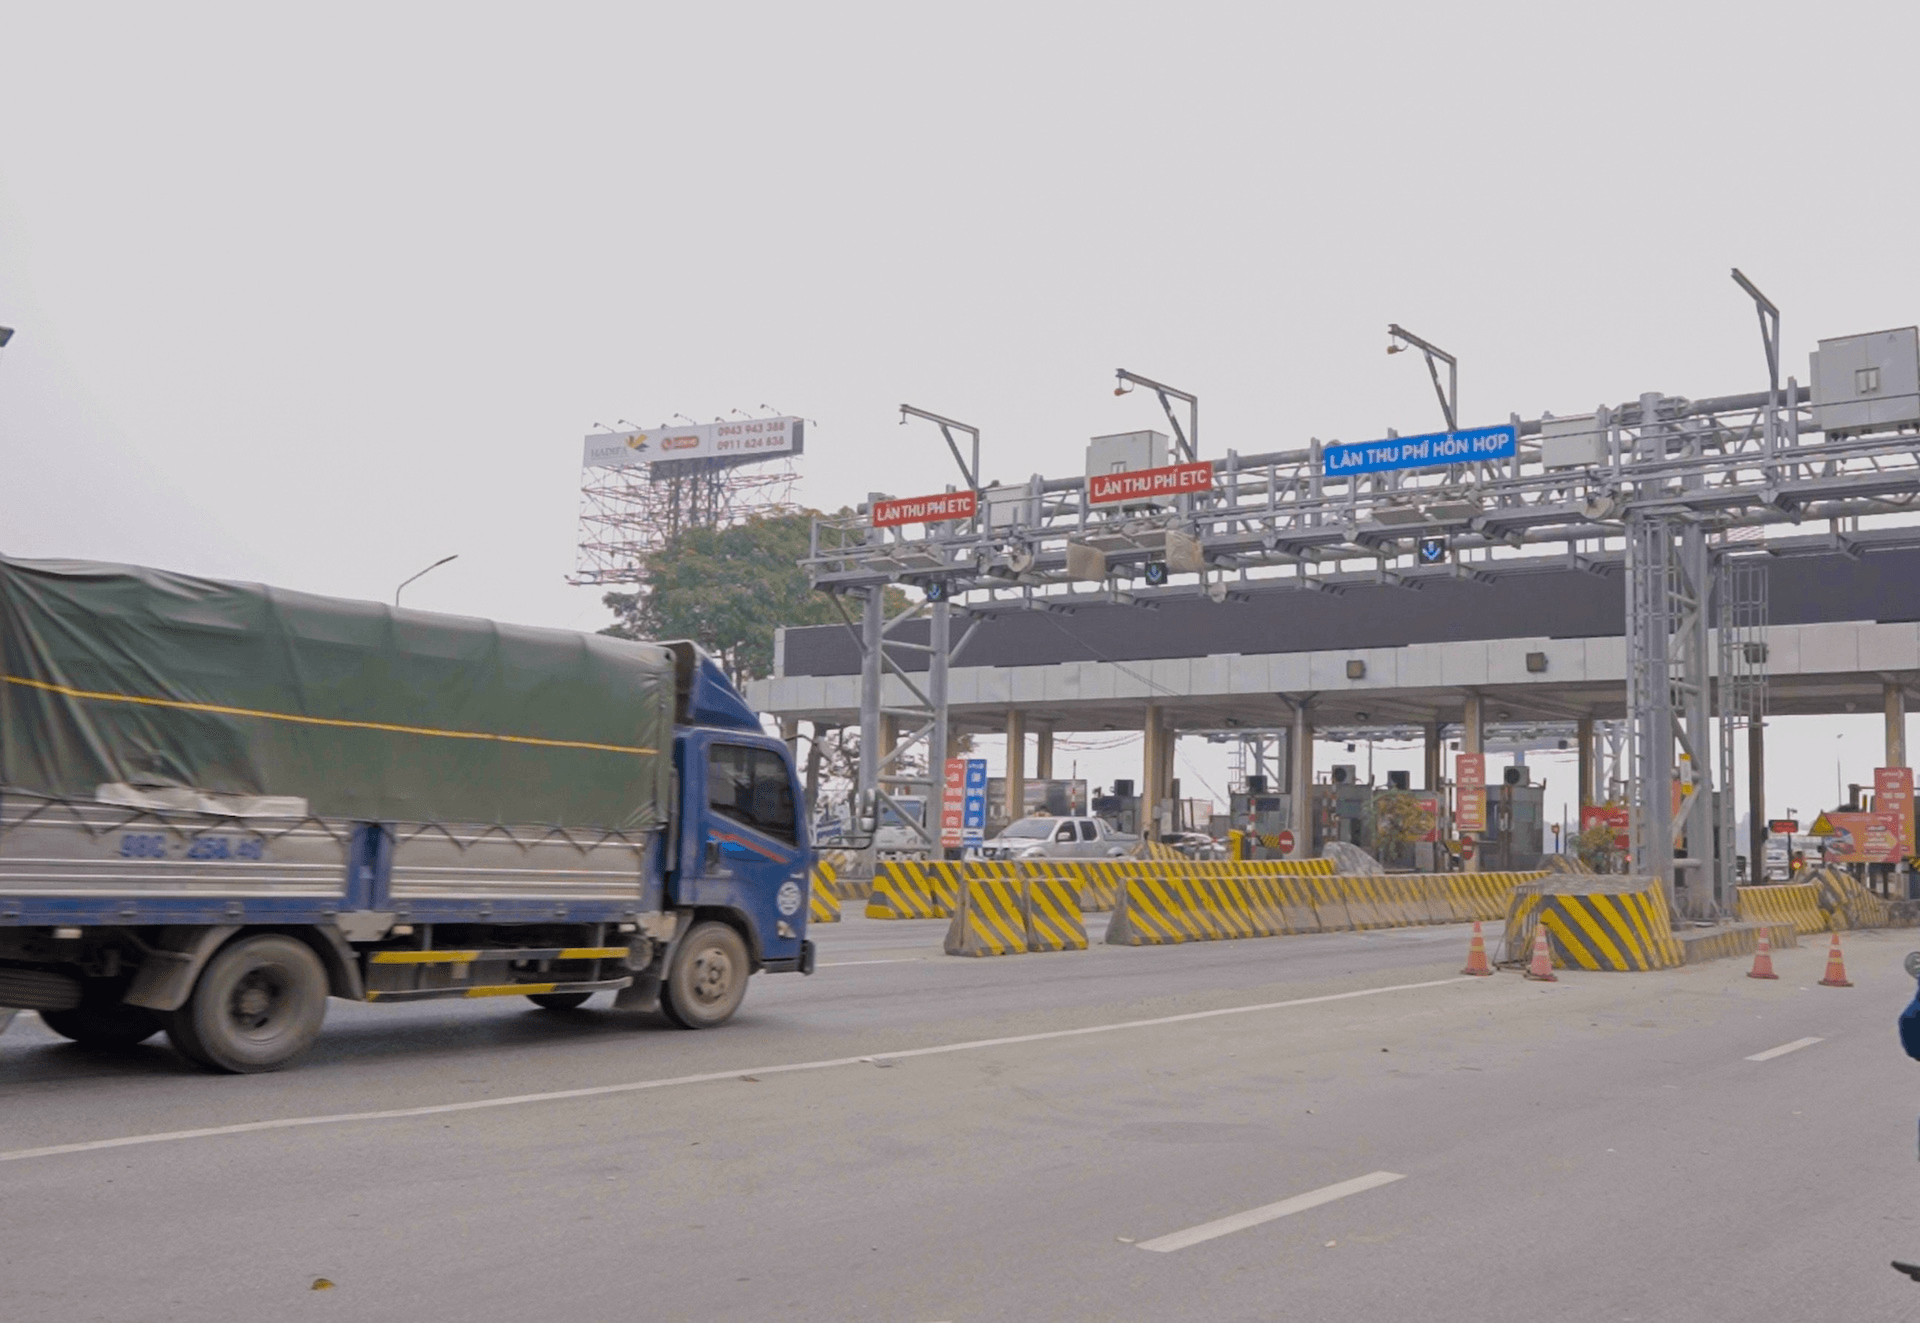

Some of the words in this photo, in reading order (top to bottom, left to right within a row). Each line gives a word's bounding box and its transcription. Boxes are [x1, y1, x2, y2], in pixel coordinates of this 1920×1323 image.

[1366, 447, 1399, 464] THU
[1402, 439, 1430, 460] PHÍ
[1124, 476, 1152, 493] THU
[1180, 469, 1207, 486] ETC
[901, 503, 925, 518] THU
[948, 497, 971, 513] ETC
